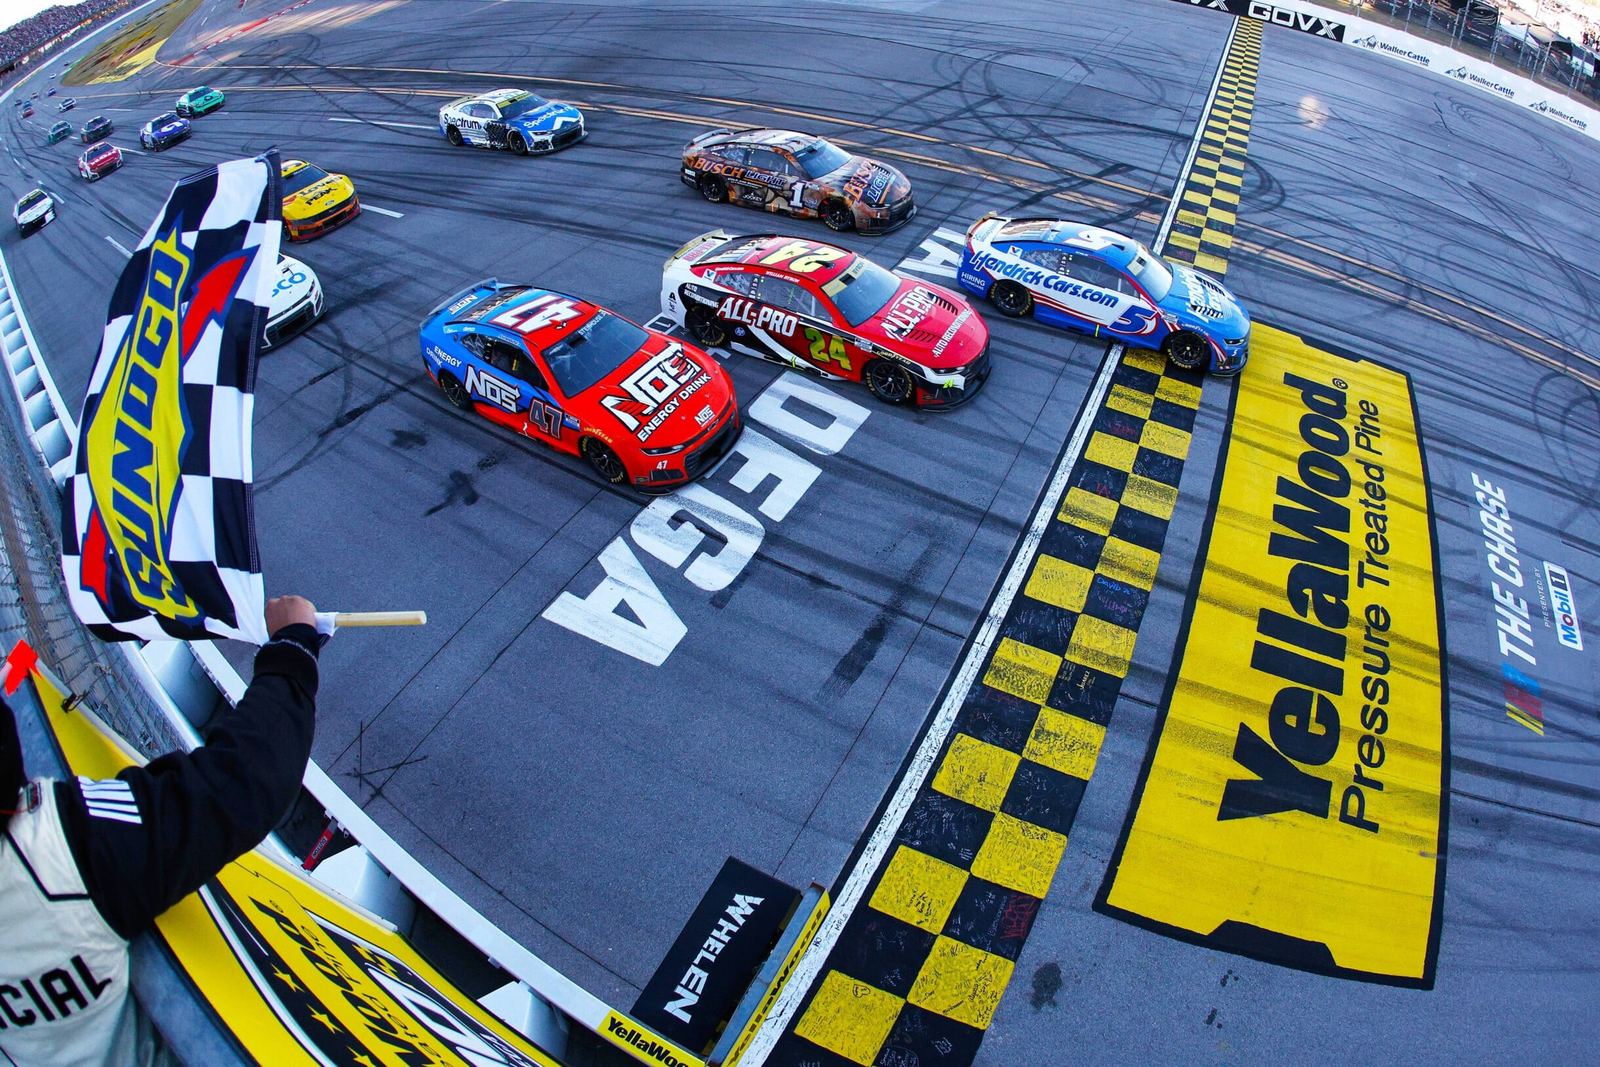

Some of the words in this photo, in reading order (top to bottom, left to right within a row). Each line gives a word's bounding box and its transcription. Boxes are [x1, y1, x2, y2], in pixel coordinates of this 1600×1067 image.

[1248, 3, 1339, 40] GOVX
[443, 113, 481, 130] Spectrum
[694, 157, 744, 179] BUSCH
[745, 169, 786, 188] LIGHT
[789, 181, 806, 209] 1
[961, 271, 986, 288] HIRING
[969, 250, 1120, 309] HendrickCars.com
[716, 296, 799, 338] ALL-PRO
[1108, 304, 1158, 335] 5
[433, 345, 463, 368] ENERGY
[804, 327, 853, 372] 24
[465, 364, 521, 413] NOS
[637, 397, 681, 443] ENERGY
[677, 372, 714, 401] DRINK
[111, 246, 187, 606] SUNOCO
[530, 398, 563, 440] 47
[1356, 398, 1382, 457] Pine
[656, 460, 669, 472] 47
[1356, 461, 1392, 588] Treated
[1470, 471, 1525, 588] CHASE
[1490, 581, 1537, 666] THE
[1553, 591, 1578, 645] Mobil
[1338, 603, 1392, 834] Pressure
[662, 893, 766, 1025] WHELEN
[0, 954, 113, 1030] CIAL
